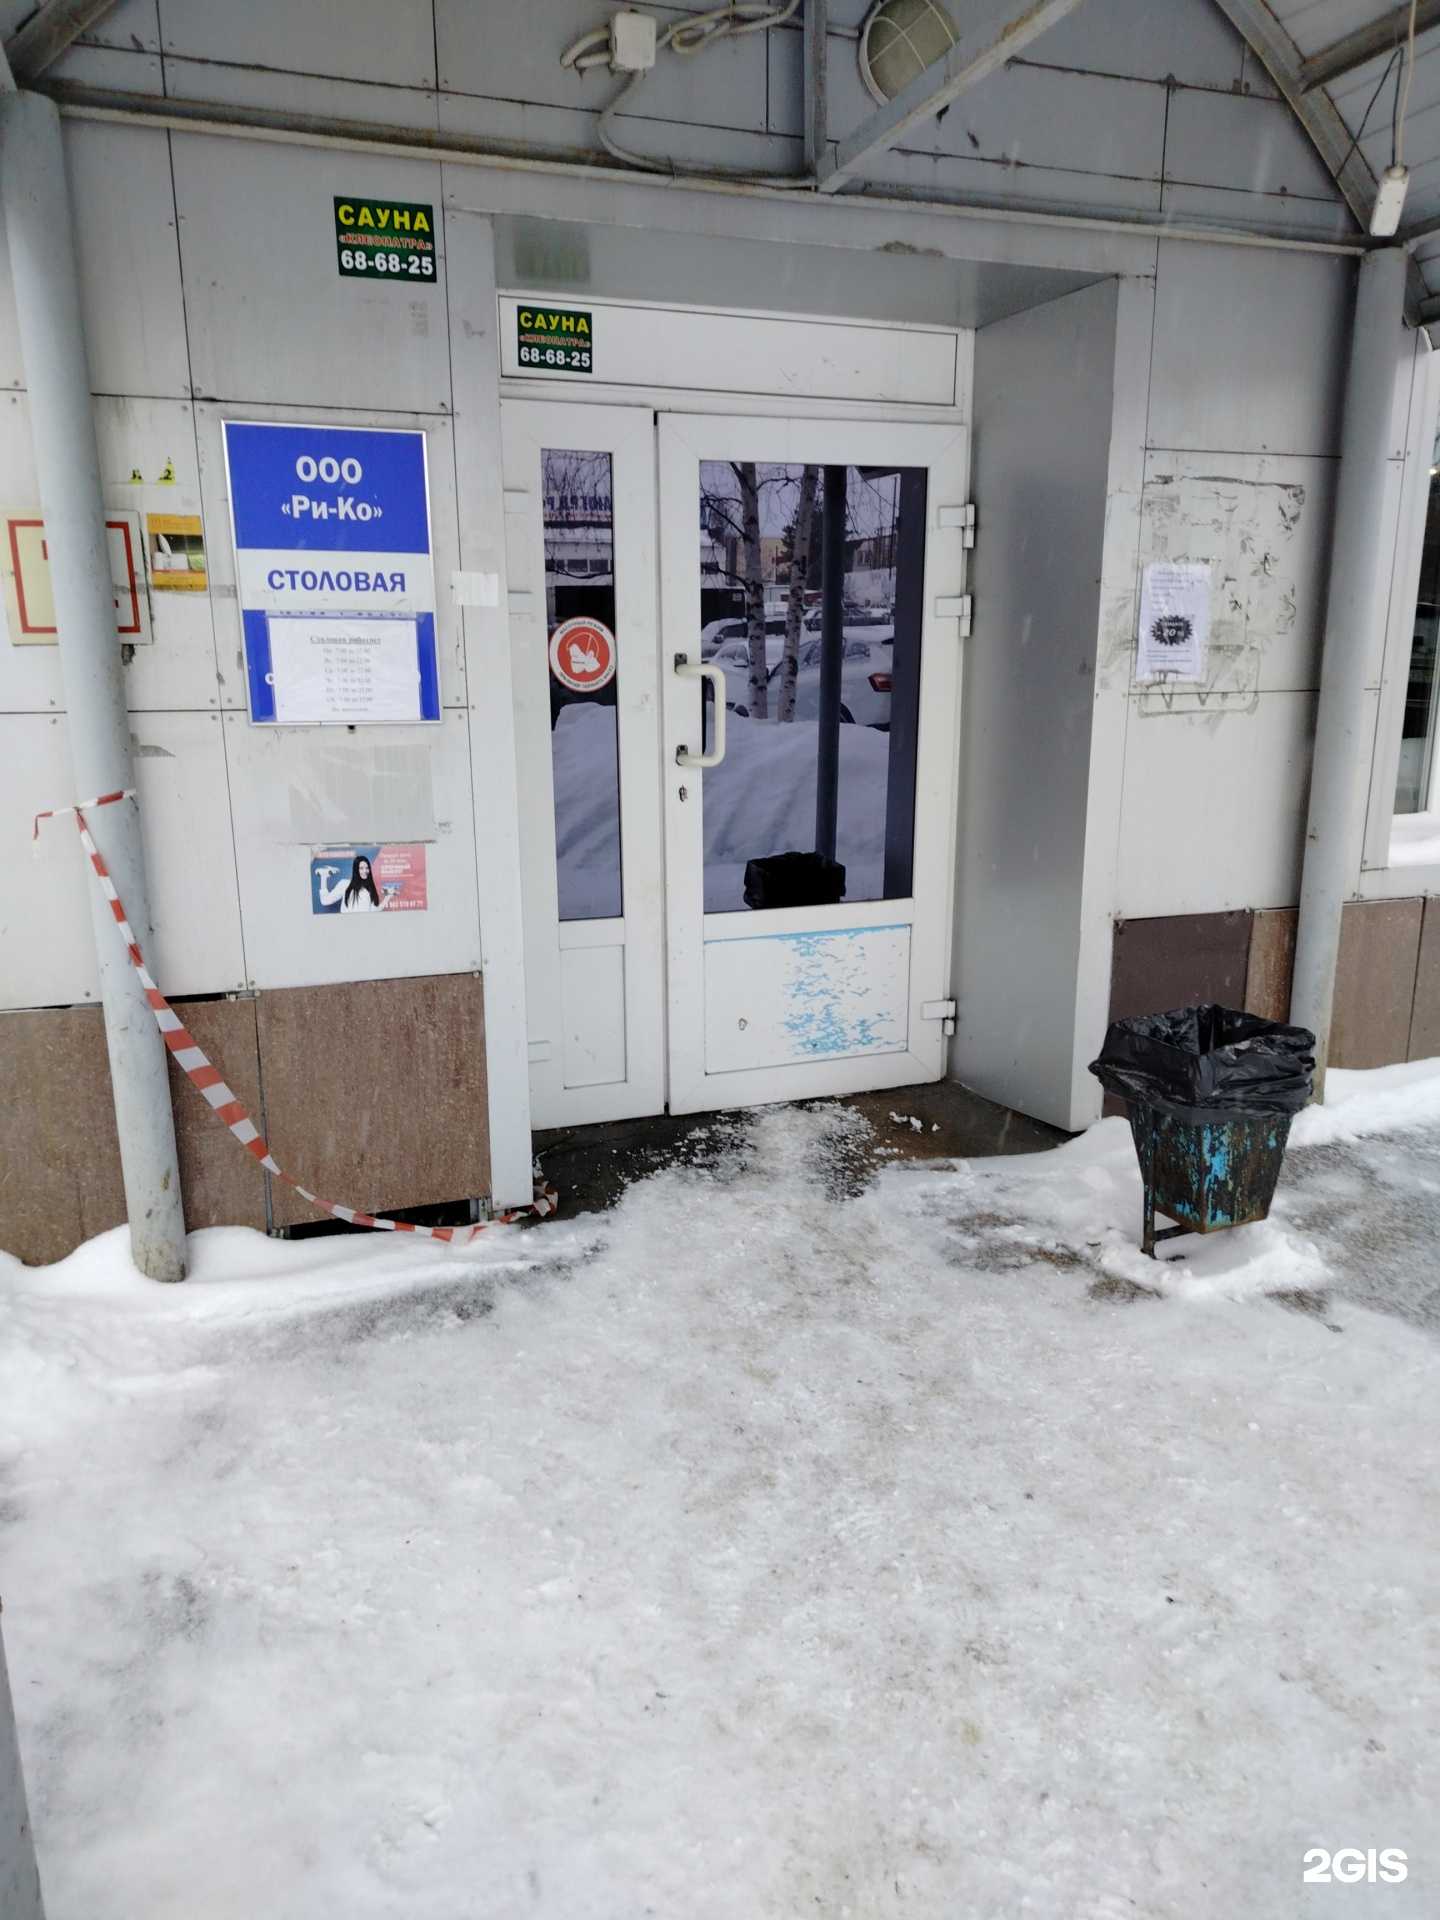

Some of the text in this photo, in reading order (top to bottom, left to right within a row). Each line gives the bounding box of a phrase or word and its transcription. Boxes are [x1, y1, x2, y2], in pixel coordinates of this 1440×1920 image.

[338, 204, 430, 232] САУНА
[341, 249, 434, 275] 68-68-25
[520, 311, 589, 333] САУНА
[520, 346, 590, 367] 68-68-25
[296, 455, 363, 484] ООО
[281, 494, 383, 521] «Ри-Ко»
[267, 569, 406, 593] СТОЛОВАЯ
